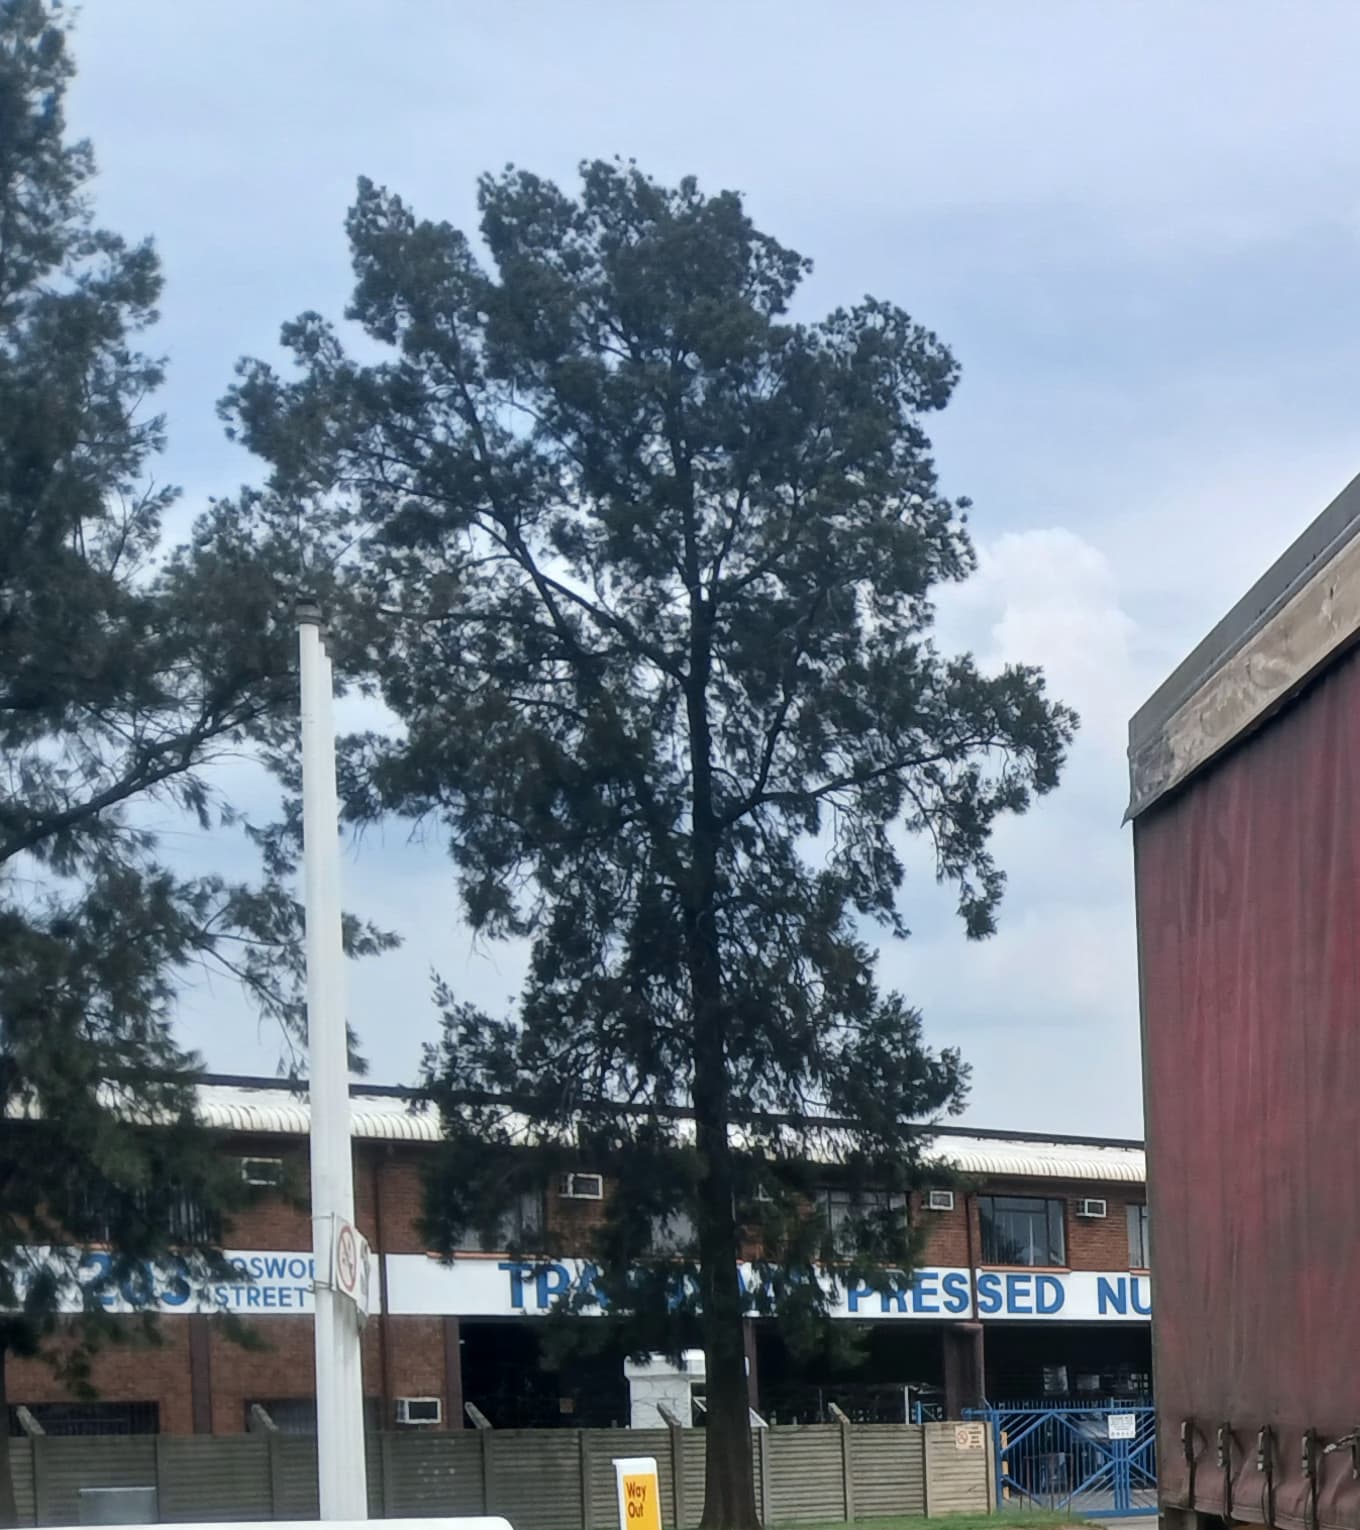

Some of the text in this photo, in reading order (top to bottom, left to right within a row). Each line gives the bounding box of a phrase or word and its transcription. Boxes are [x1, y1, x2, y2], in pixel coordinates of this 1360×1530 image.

[214, 1285, 305, 1308] STREET
[848, 1272, 1065, 1315] PRESSED
[626, 1481, 647, 1503] Way
[627, 1501, 644, 1519] Out
